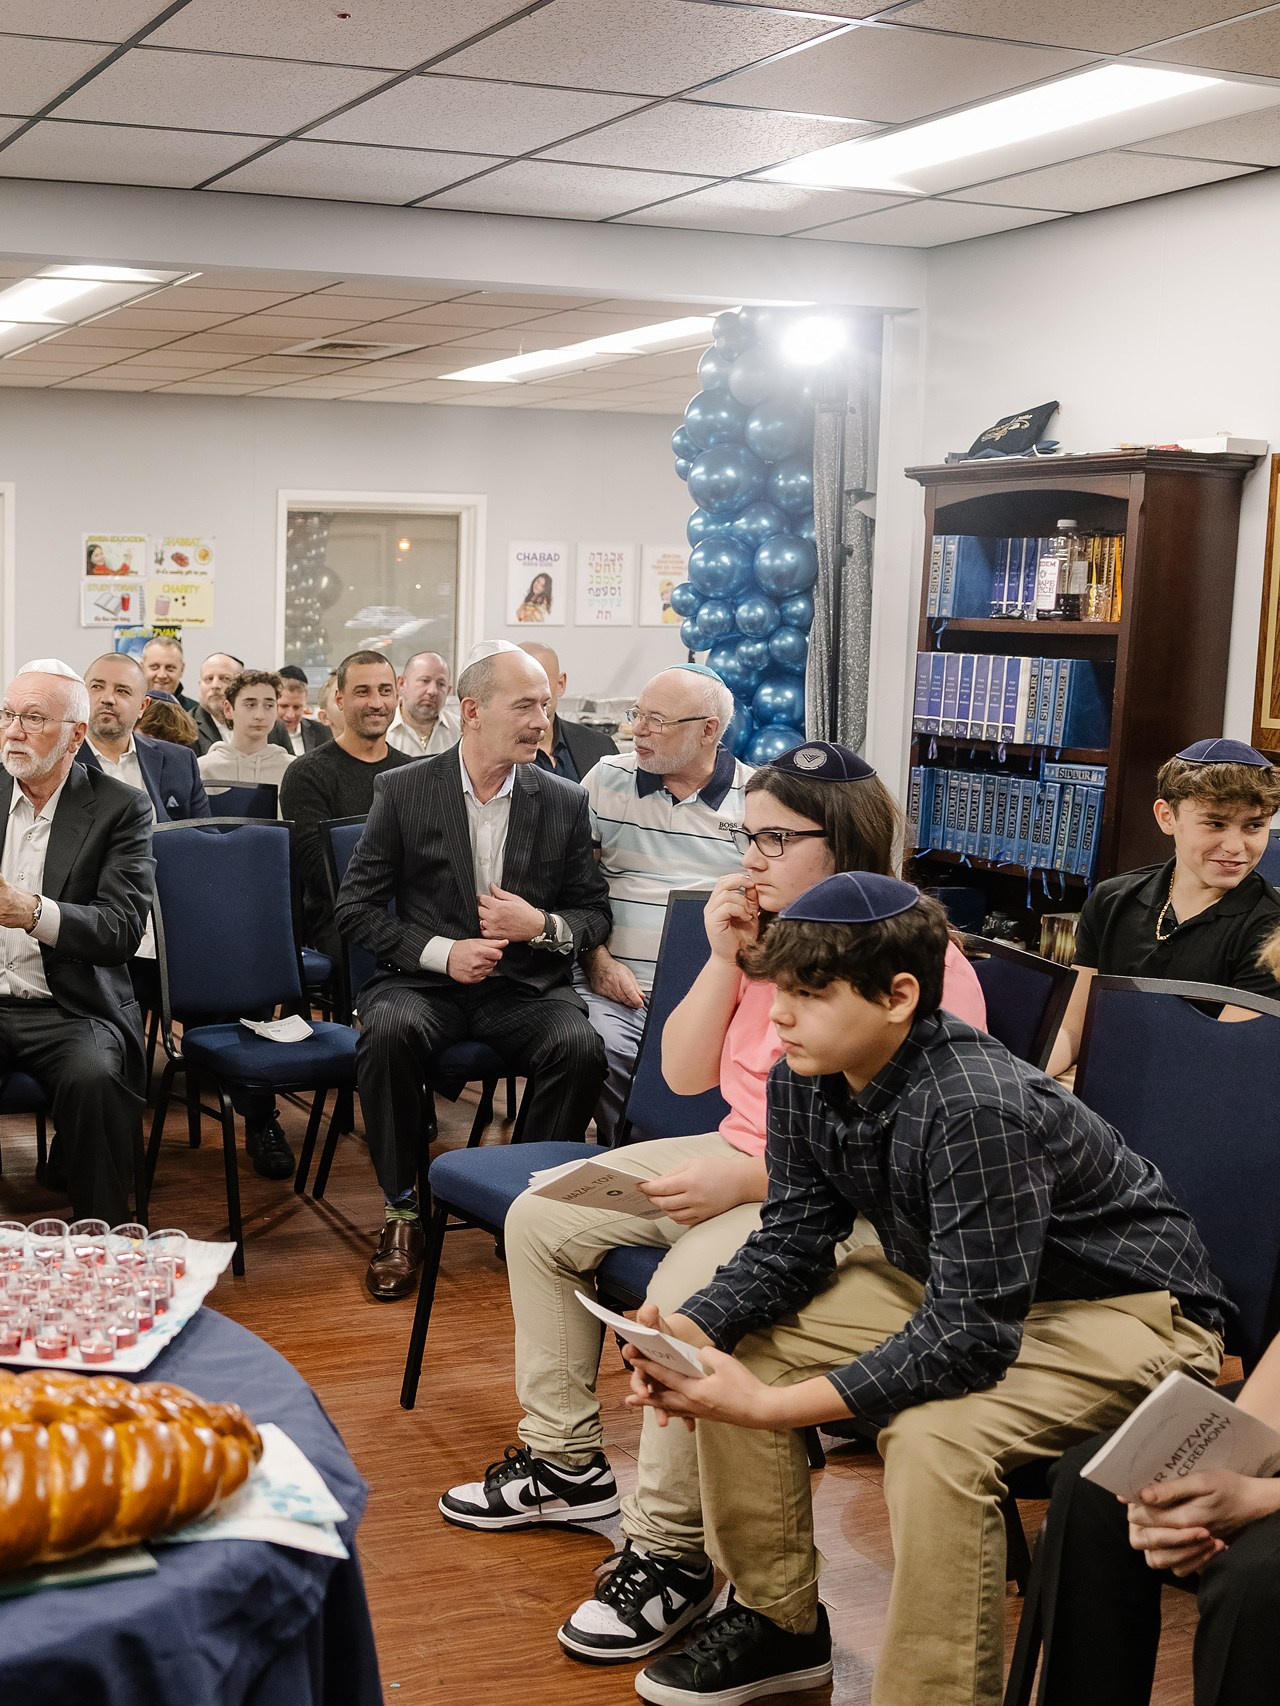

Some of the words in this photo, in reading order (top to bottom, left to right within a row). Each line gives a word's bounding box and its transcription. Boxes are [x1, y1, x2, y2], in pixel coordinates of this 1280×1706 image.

[516, 552, 560, 562] CHABAD
[930, 551, 941, 593] SIDDUR
[943, 551, 954, 593] SIDDUR
[1027, 675, 1038, 718] SIDDUR
[1040, 677, 1051, 720] SIDDUR
[1055, 676, 1066, 720] SIDDUR
[1059, 768, 1091, 780] SIDDUR
[911, 783, 920, 824] SIDDUR
[932, 784, 943, 825] SIDDUR
[947, 787, 957, 828] SIDDUR
[957, 789, 967, 830] SIDDUR
[969, 790, 979, 832] SIDDUR
[982, 792, 993, 834] SIDDUR
[995, 793, 1006, 836] SIDDUR
[1007, 795, 1018, 838] SIDDUR
[1020, 796, 1031, 840] SIDDUR
[1042, 801, 1054, 844] SIDDUR
[1058, 801, 1069, 846] SIDDUR
[719, 821, 738, 829] BOSS
[1069, 803, 1081, 848] SIDDUR
[1083, 805, 1096, 850] SIDDUR
[562, 1184, 597, 1201] MAZAL
[1164, 1411, 1220, 1470] MITZVAH
[1177, 1416, 1232, 1478] CEREMONY
